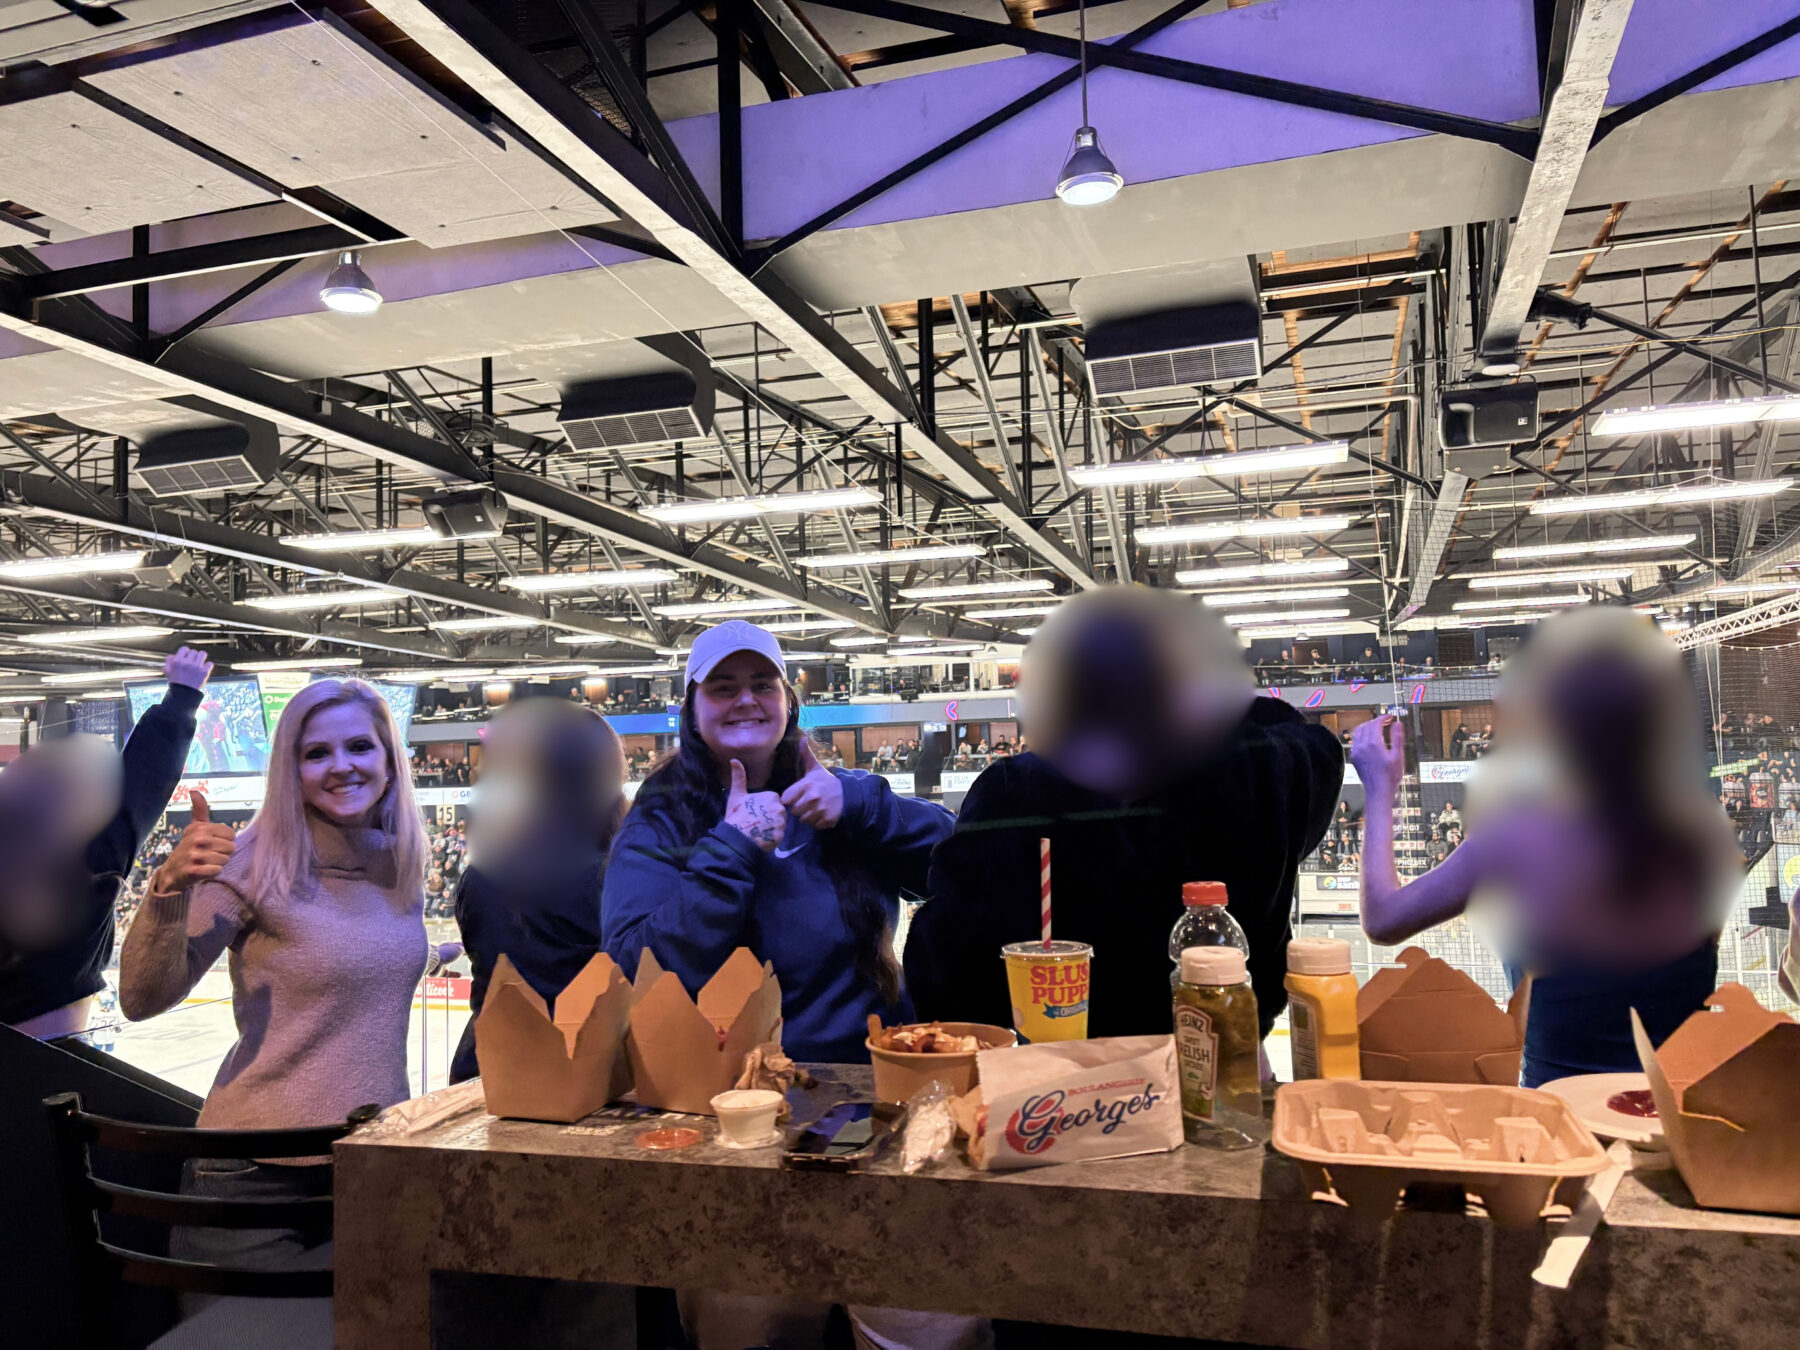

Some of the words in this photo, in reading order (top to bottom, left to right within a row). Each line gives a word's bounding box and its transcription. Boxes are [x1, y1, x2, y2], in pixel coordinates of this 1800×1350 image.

[438, 806, 453, 822] 15
[1031, 962, 1088, 986] SLUS
[1031, 984, 1087, 1005] PUPP
[1017, 1083, 1160, 1151] Georges
